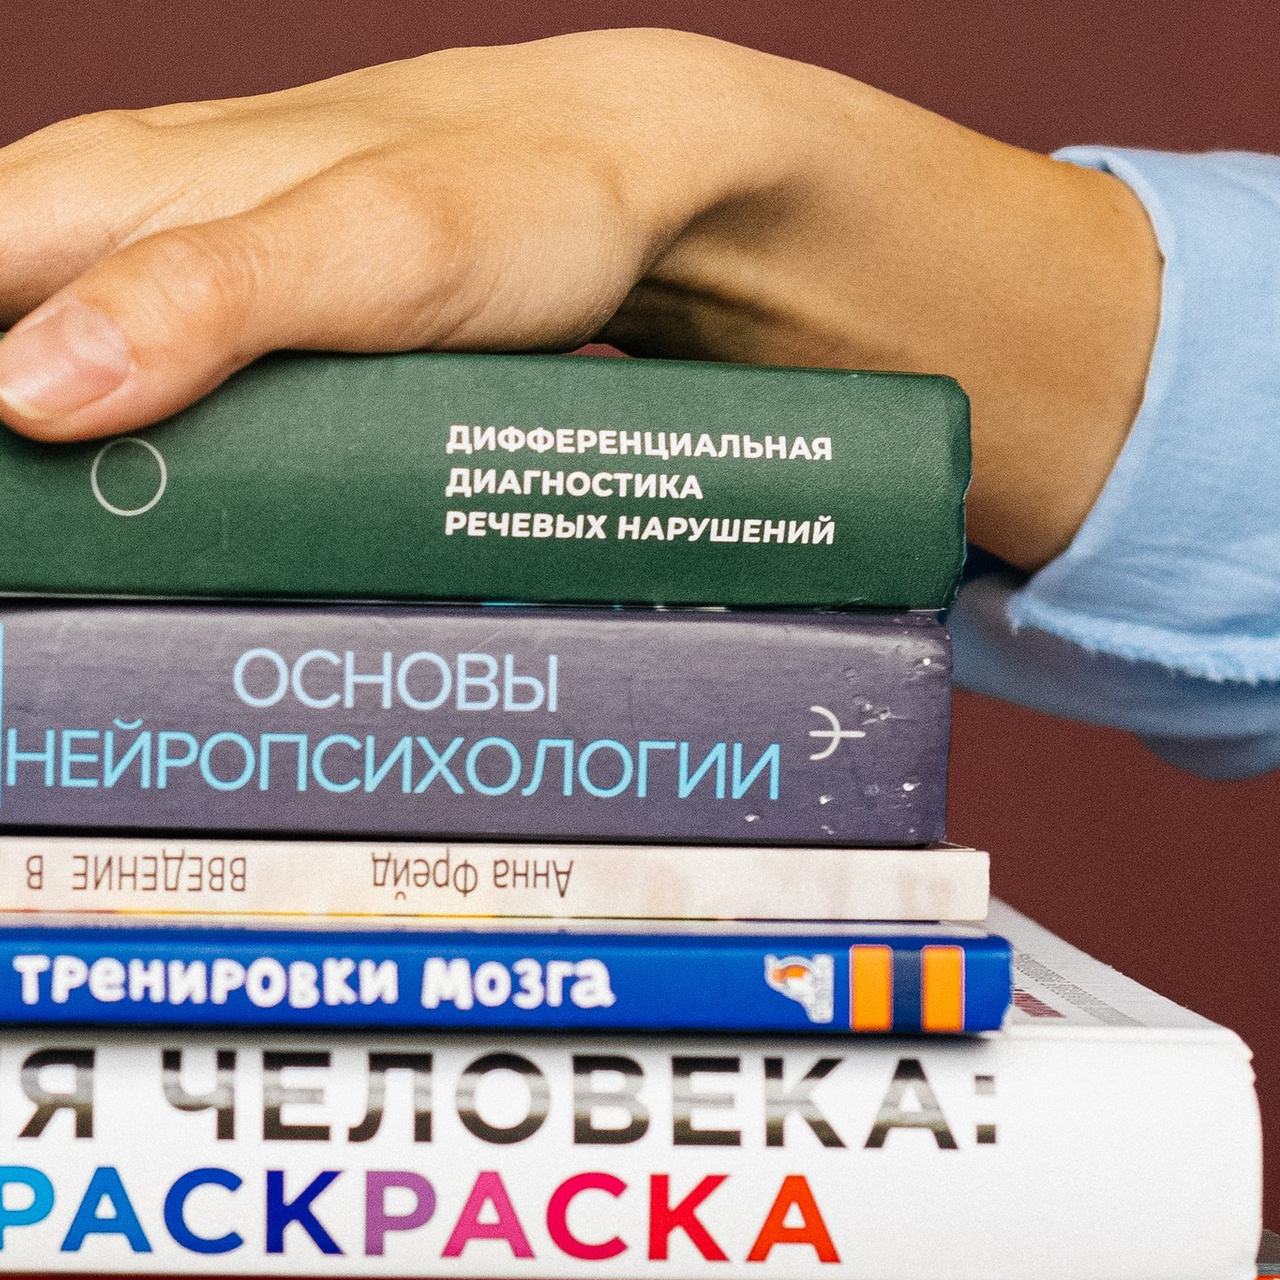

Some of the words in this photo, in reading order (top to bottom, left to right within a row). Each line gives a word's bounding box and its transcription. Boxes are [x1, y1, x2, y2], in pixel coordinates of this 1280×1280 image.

[445, 425, 833, 462] ДИФФЕРЕНЦИАЛЬНАЯ
[445, 469, 703, 501] ДИАГНОСТИКА
[444, 510, 607, 540] РЕЧЕВЫХ
[617, 512, 836, 546] НАРУШЕНИЙ
[232, 648, 559, 713] ОСНОВЫ
[6, 720, 781, 800] НЕЙРОПСИХОЛОГИИ
[25, 854, 44, 891] В
[71, 849, 247, 892] ВВЕДЕНИЕ
[371, 850, 479, 901] Фрейд
[492, 857, 575, 899] Анна
[161, 1047, 998, 1149] ЧЕЛОВЕКА:
